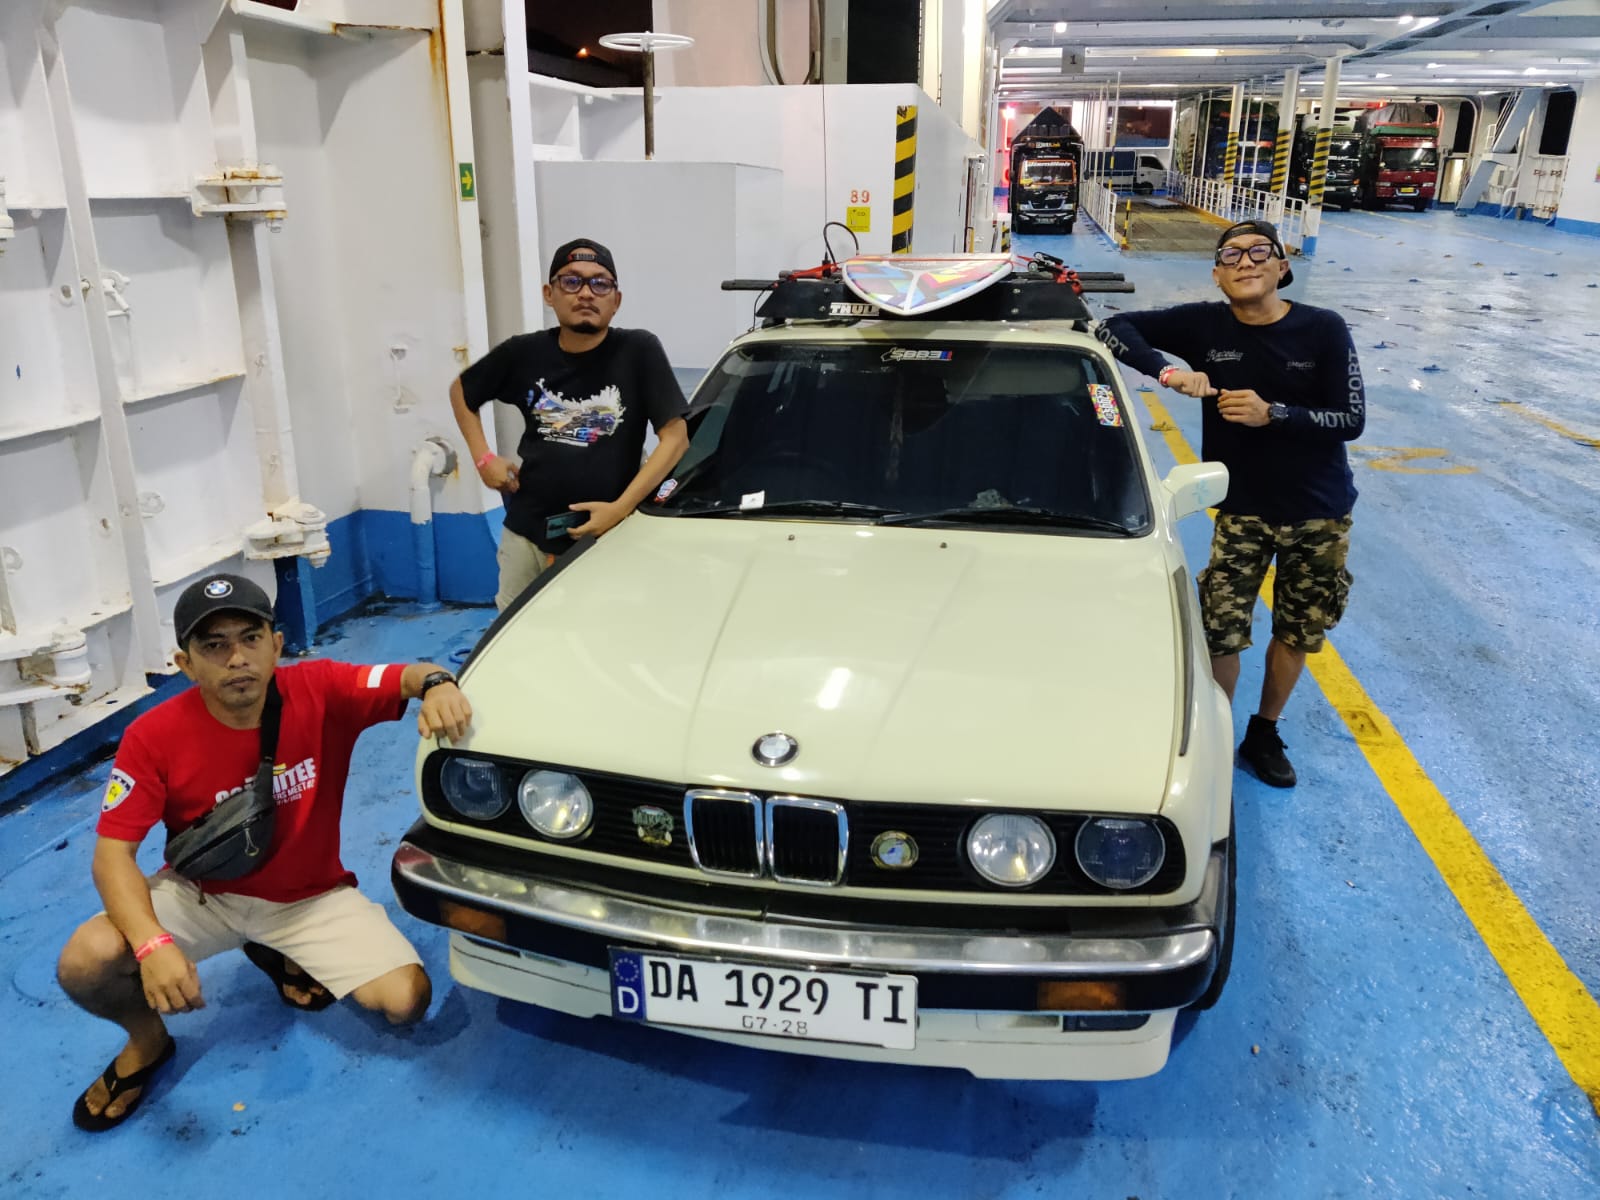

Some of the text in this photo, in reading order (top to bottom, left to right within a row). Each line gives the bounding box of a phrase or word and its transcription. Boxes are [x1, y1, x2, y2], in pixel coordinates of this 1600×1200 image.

[1070, 54, 1078, 65] 1
[617, 986, 640, 1014] D
[649, 960, 908, 1025] DA 1929 TI
